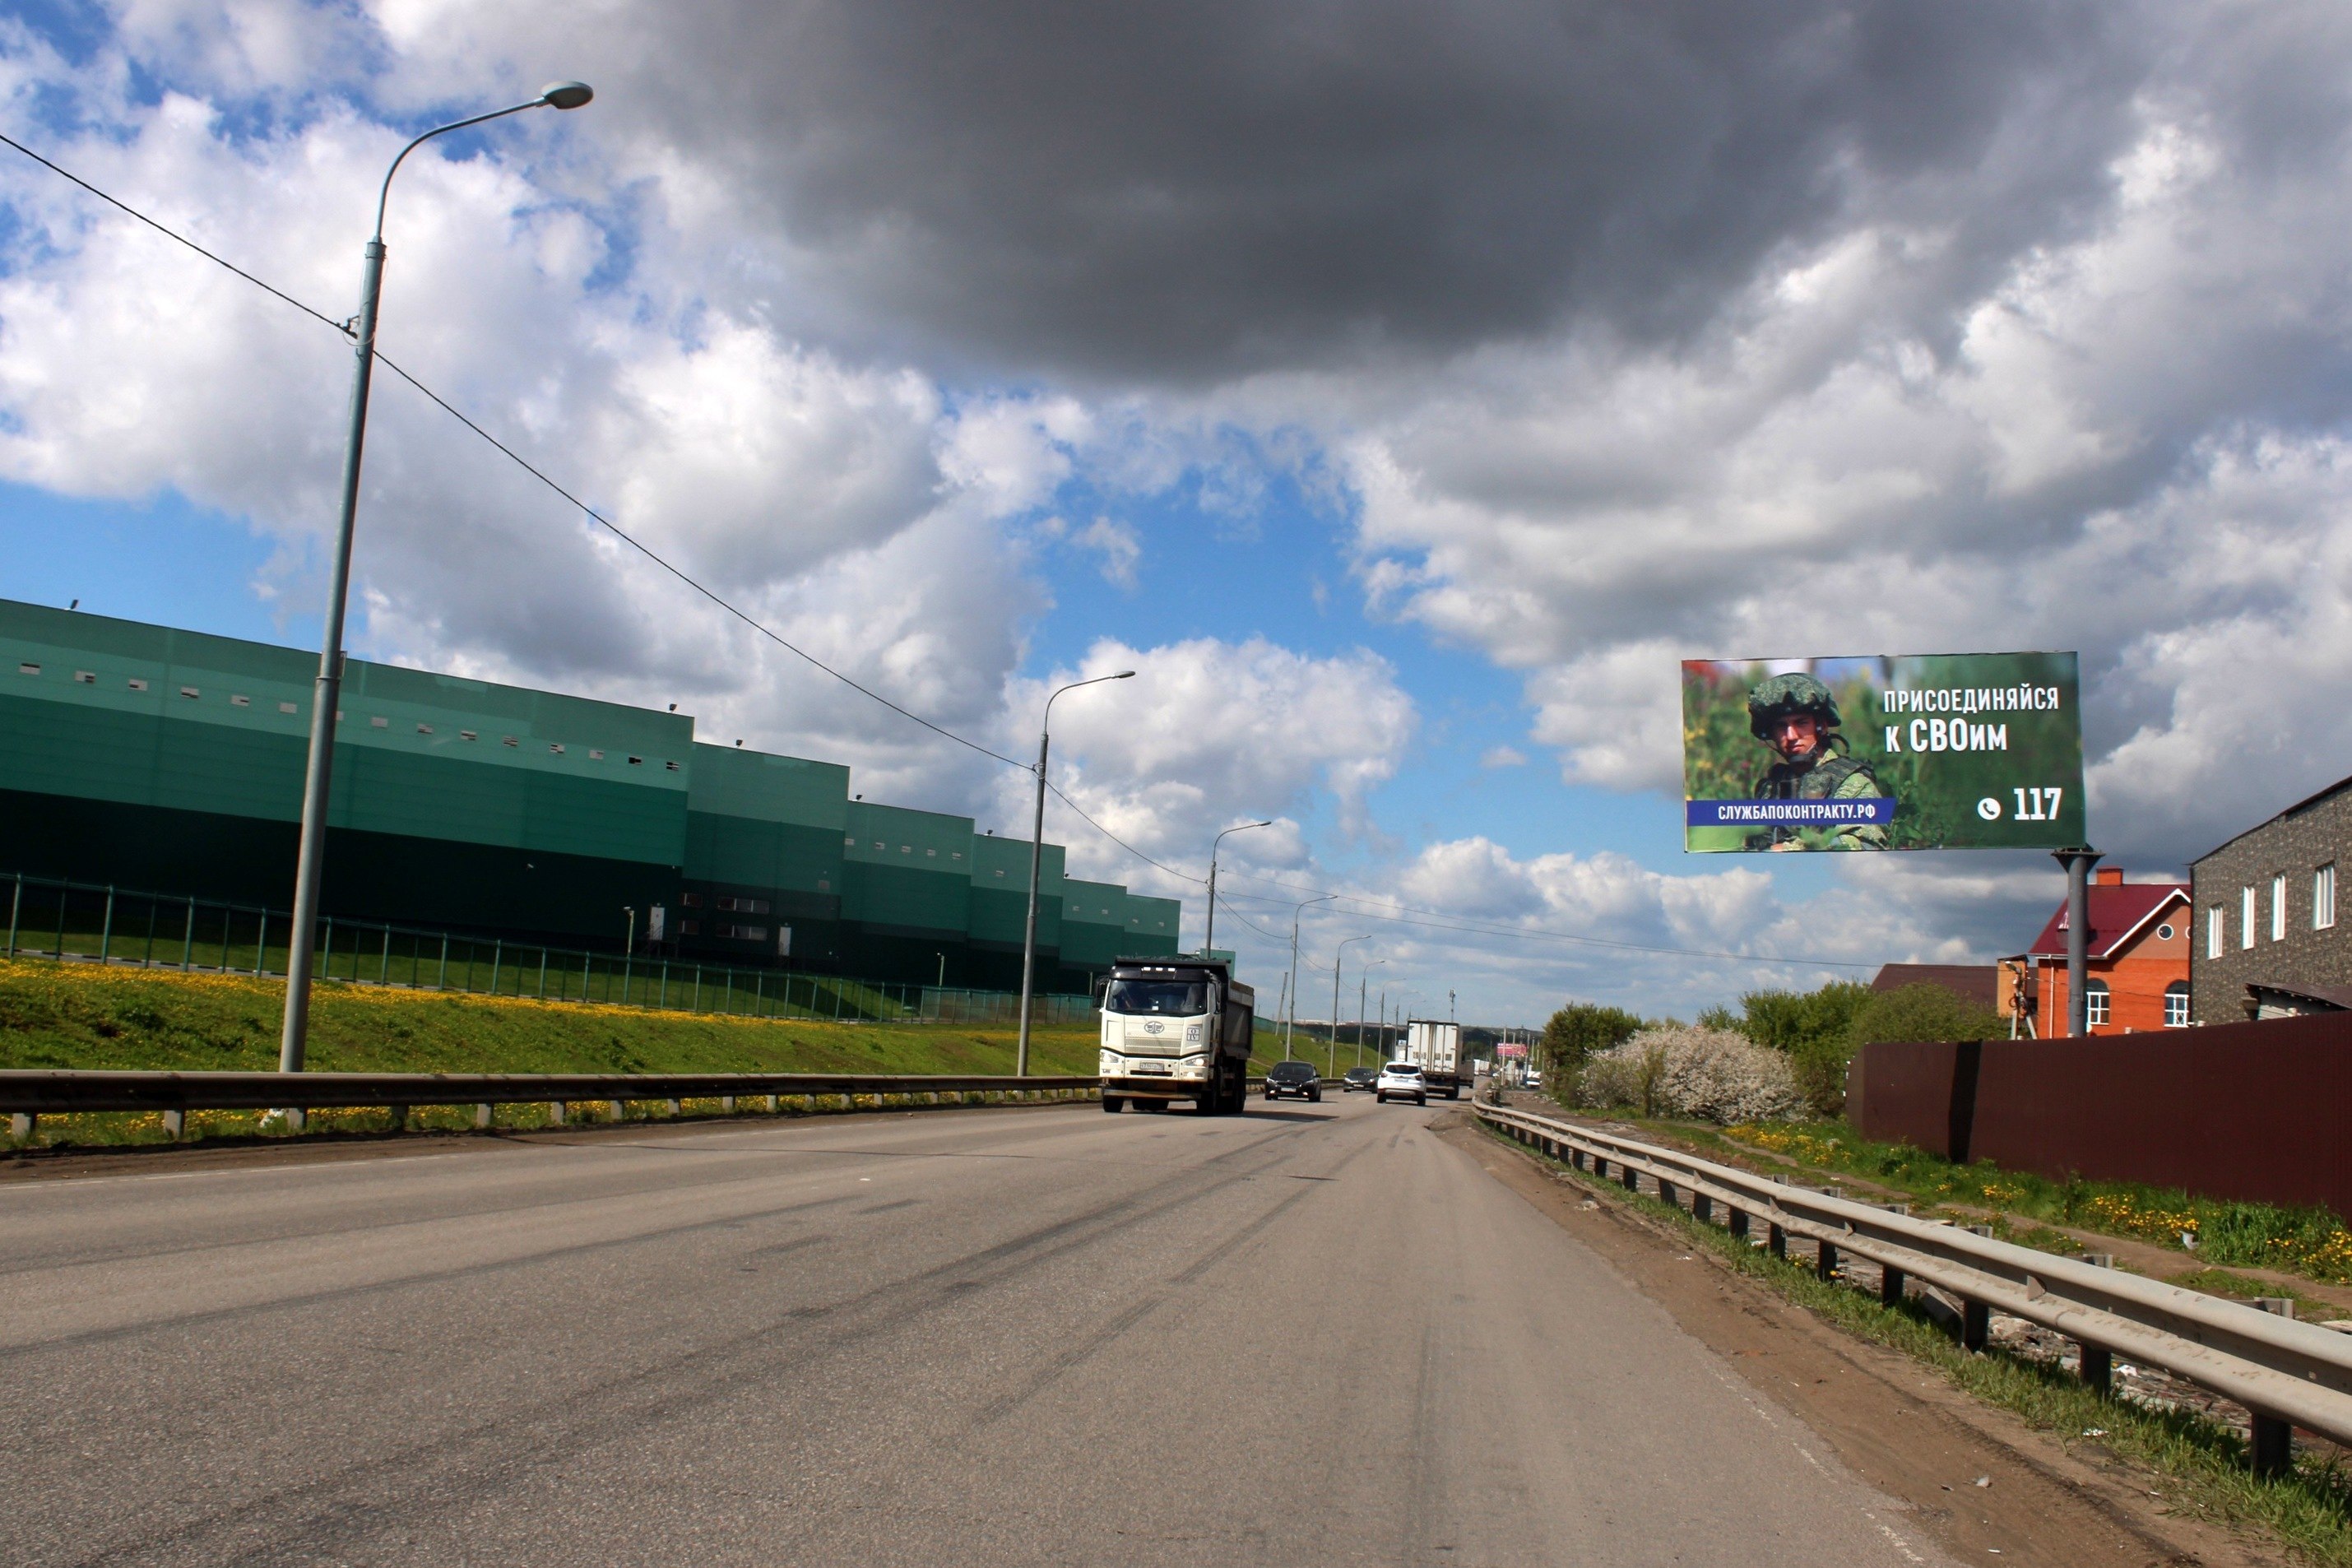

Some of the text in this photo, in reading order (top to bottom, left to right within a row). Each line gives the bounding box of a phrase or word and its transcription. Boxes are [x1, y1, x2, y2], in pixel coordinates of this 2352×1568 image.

[1884, 683, 2059, 713] ПРИСОЕДИНЯЙСЯ
[1718, 804, 1876, 820] СЛУЖБАПОКОНТРАКТУ.РФ
[2013, 787, 2062, 821] 117
